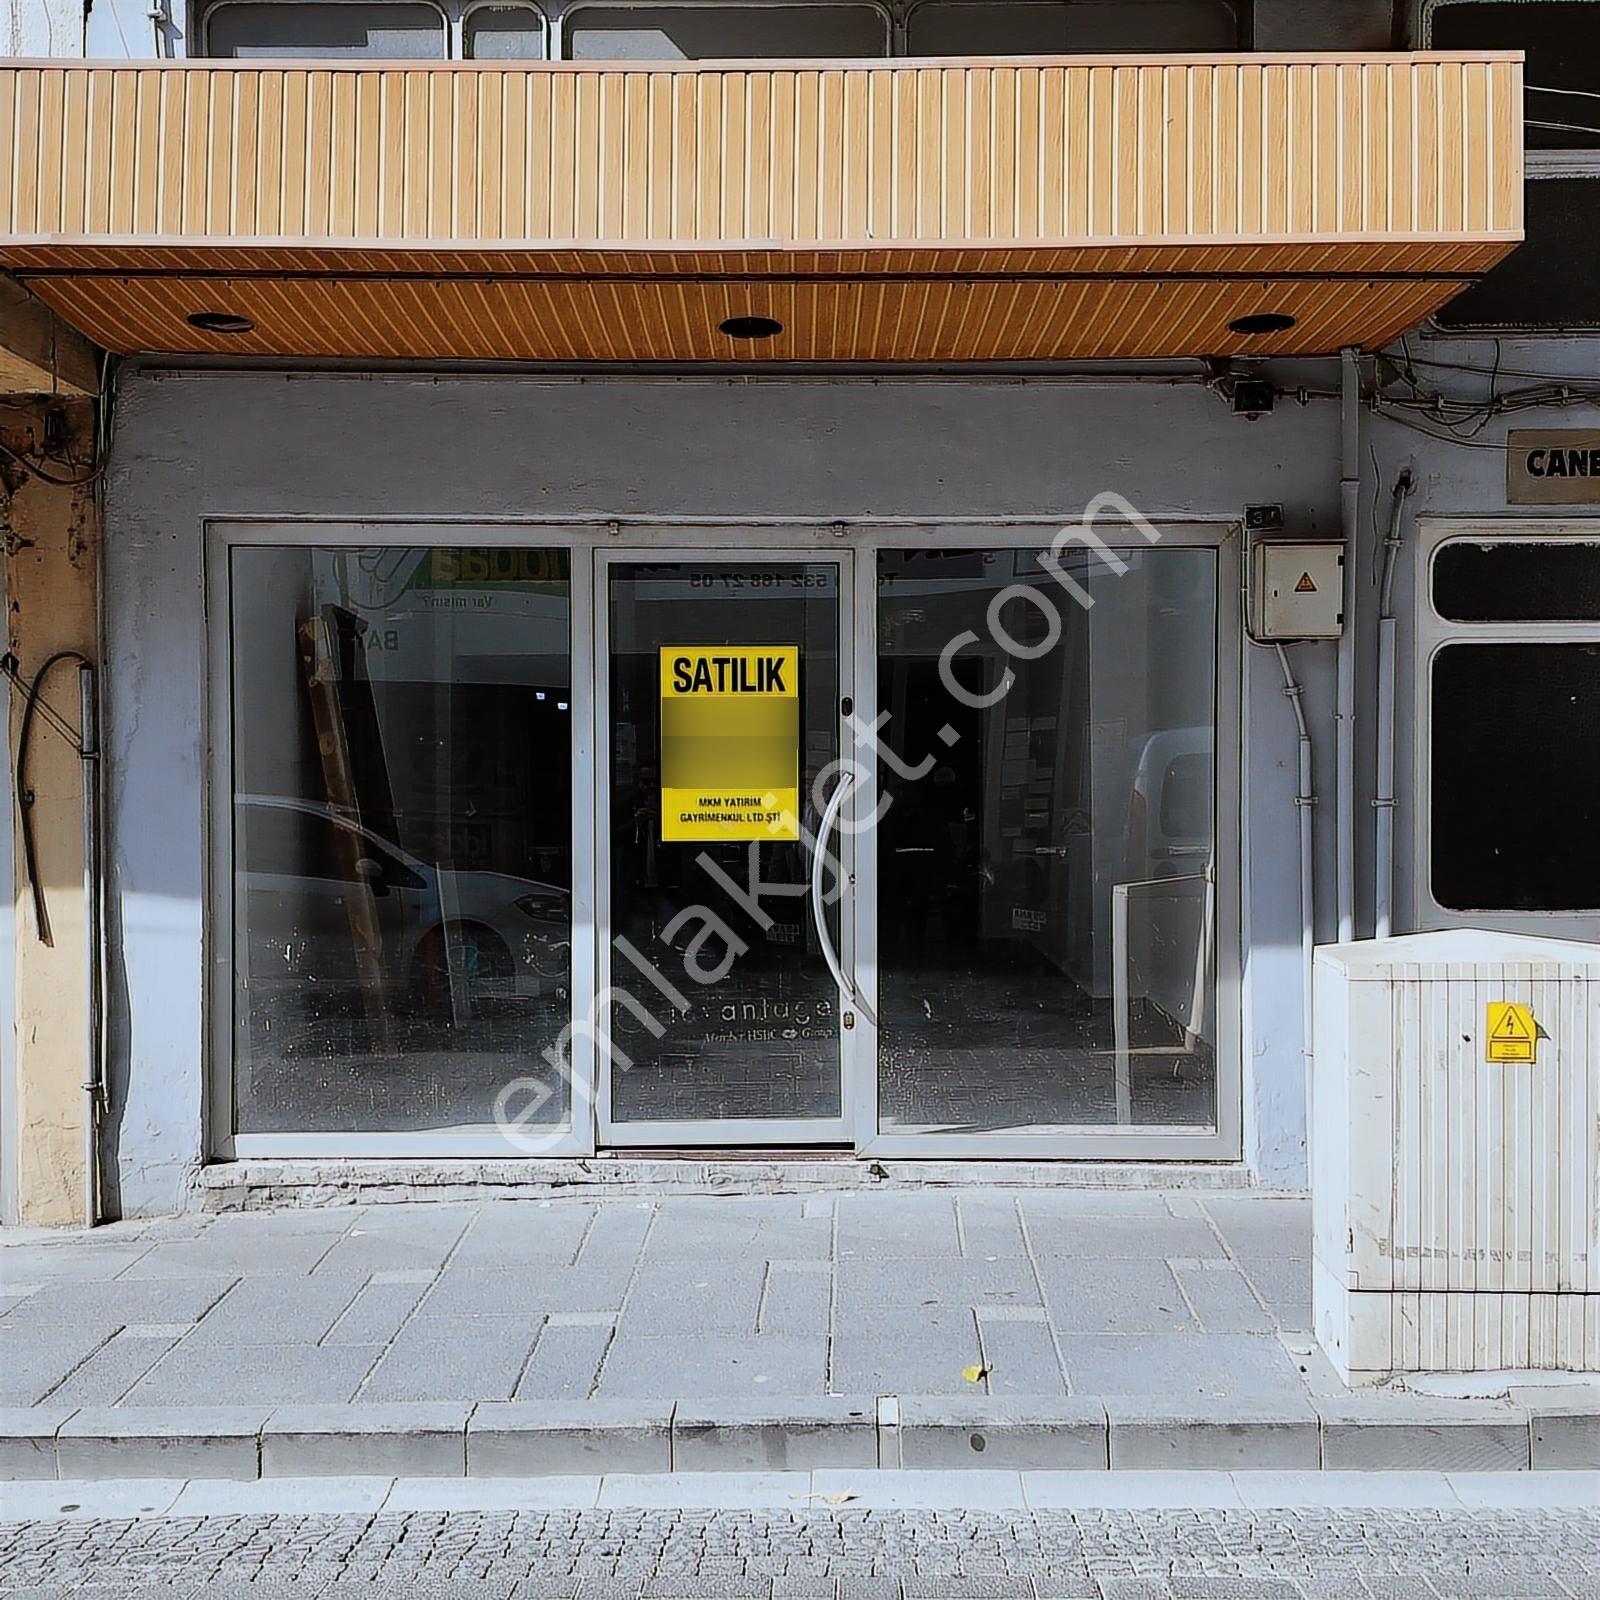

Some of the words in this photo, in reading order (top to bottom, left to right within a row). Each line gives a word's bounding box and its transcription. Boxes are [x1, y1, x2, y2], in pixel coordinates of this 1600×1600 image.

[1525, 448, 1600, 478] CANE
[673, 657, 786, 692] SATILIK
[698, 797, 721, 808] MKM
